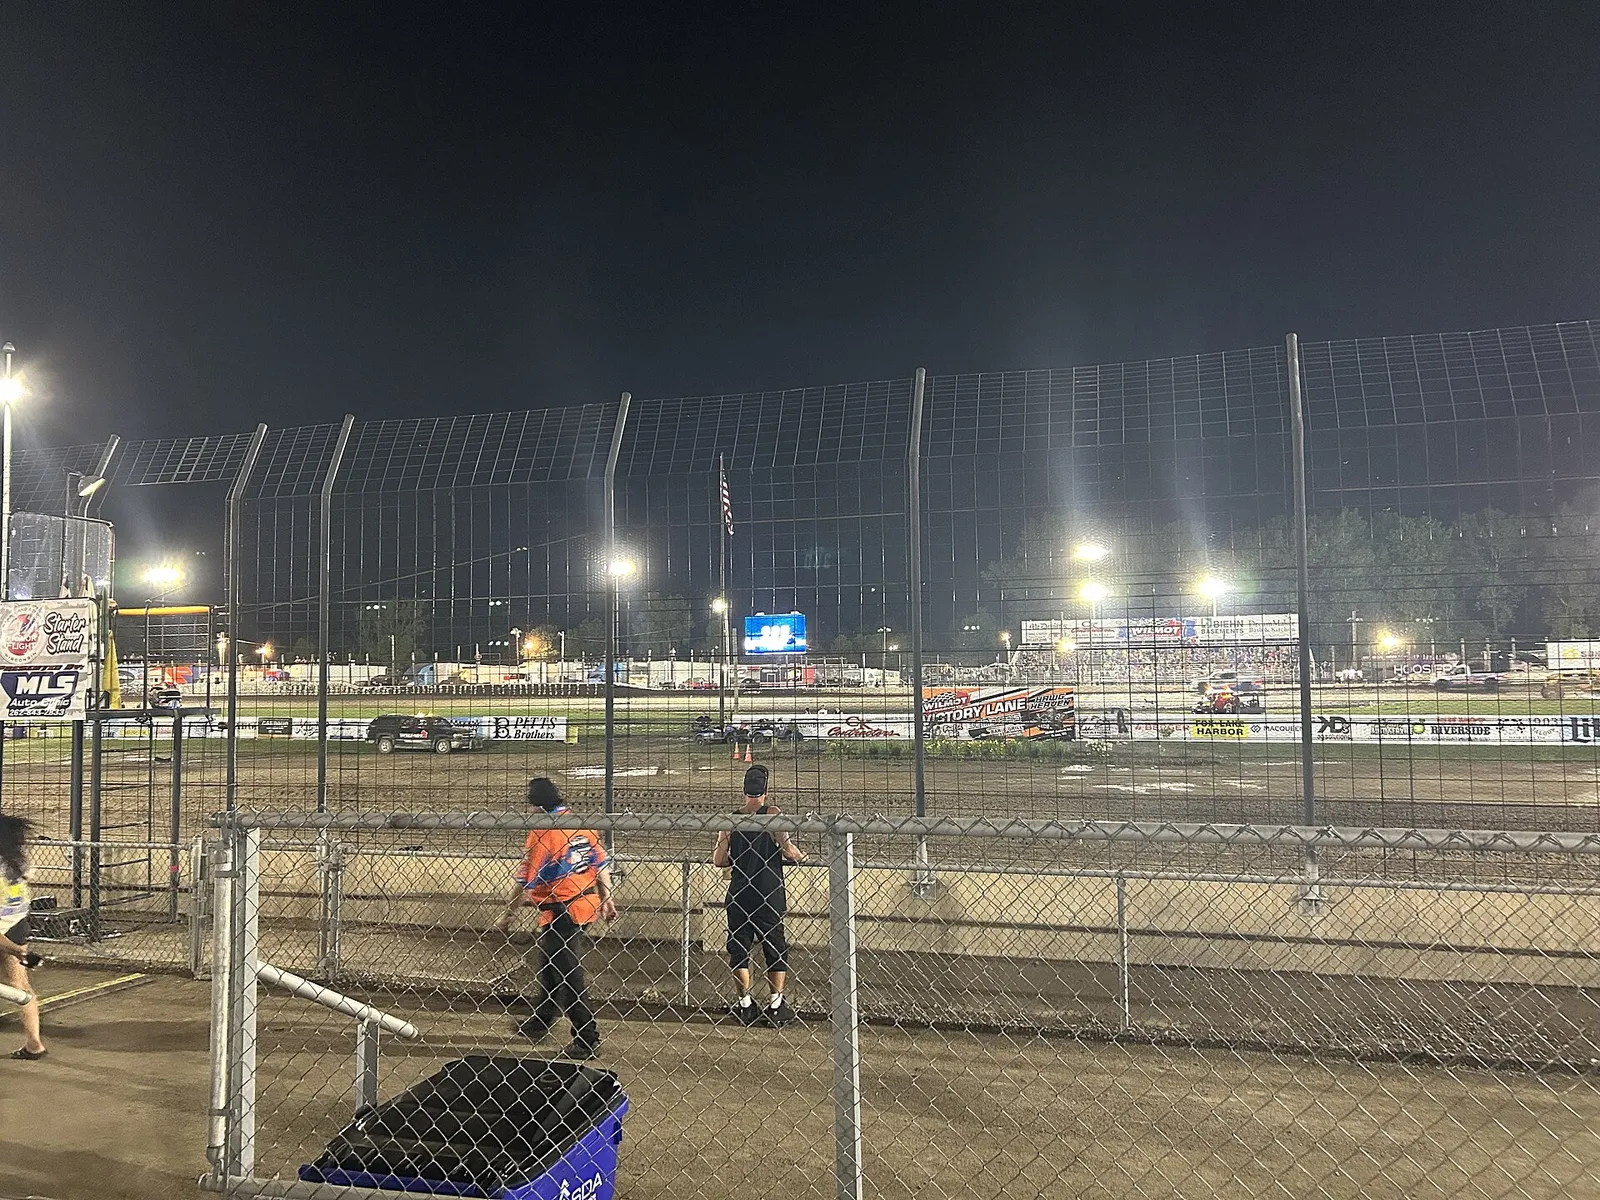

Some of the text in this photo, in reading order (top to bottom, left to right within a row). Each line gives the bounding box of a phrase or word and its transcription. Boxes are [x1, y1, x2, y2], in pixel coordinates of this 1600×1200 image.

[43, 612, 86, 634] Starter
[1213, 619, 1244, 628] BIEHN
[1131, 626, 1179, 636] WILMOT
[46, 634, 84, 654] Stand
[15, 675, 76, 695] MLS
[9, 698, 38, 707] Auto
[923, 697, 968, 711] WILMOT
[922, 705, 983, 722] VICTORY
[986, 697, 1027, 716] LANE
[514, 716, 558, 729] PITTS
[1219, 719, 1245, 727] LAKE
[513, 730, 555, 740] Brothers
[1196, 728, 1244, 736] HARBOR
[1430, 725, 1491, 735] RIVERSIDE
